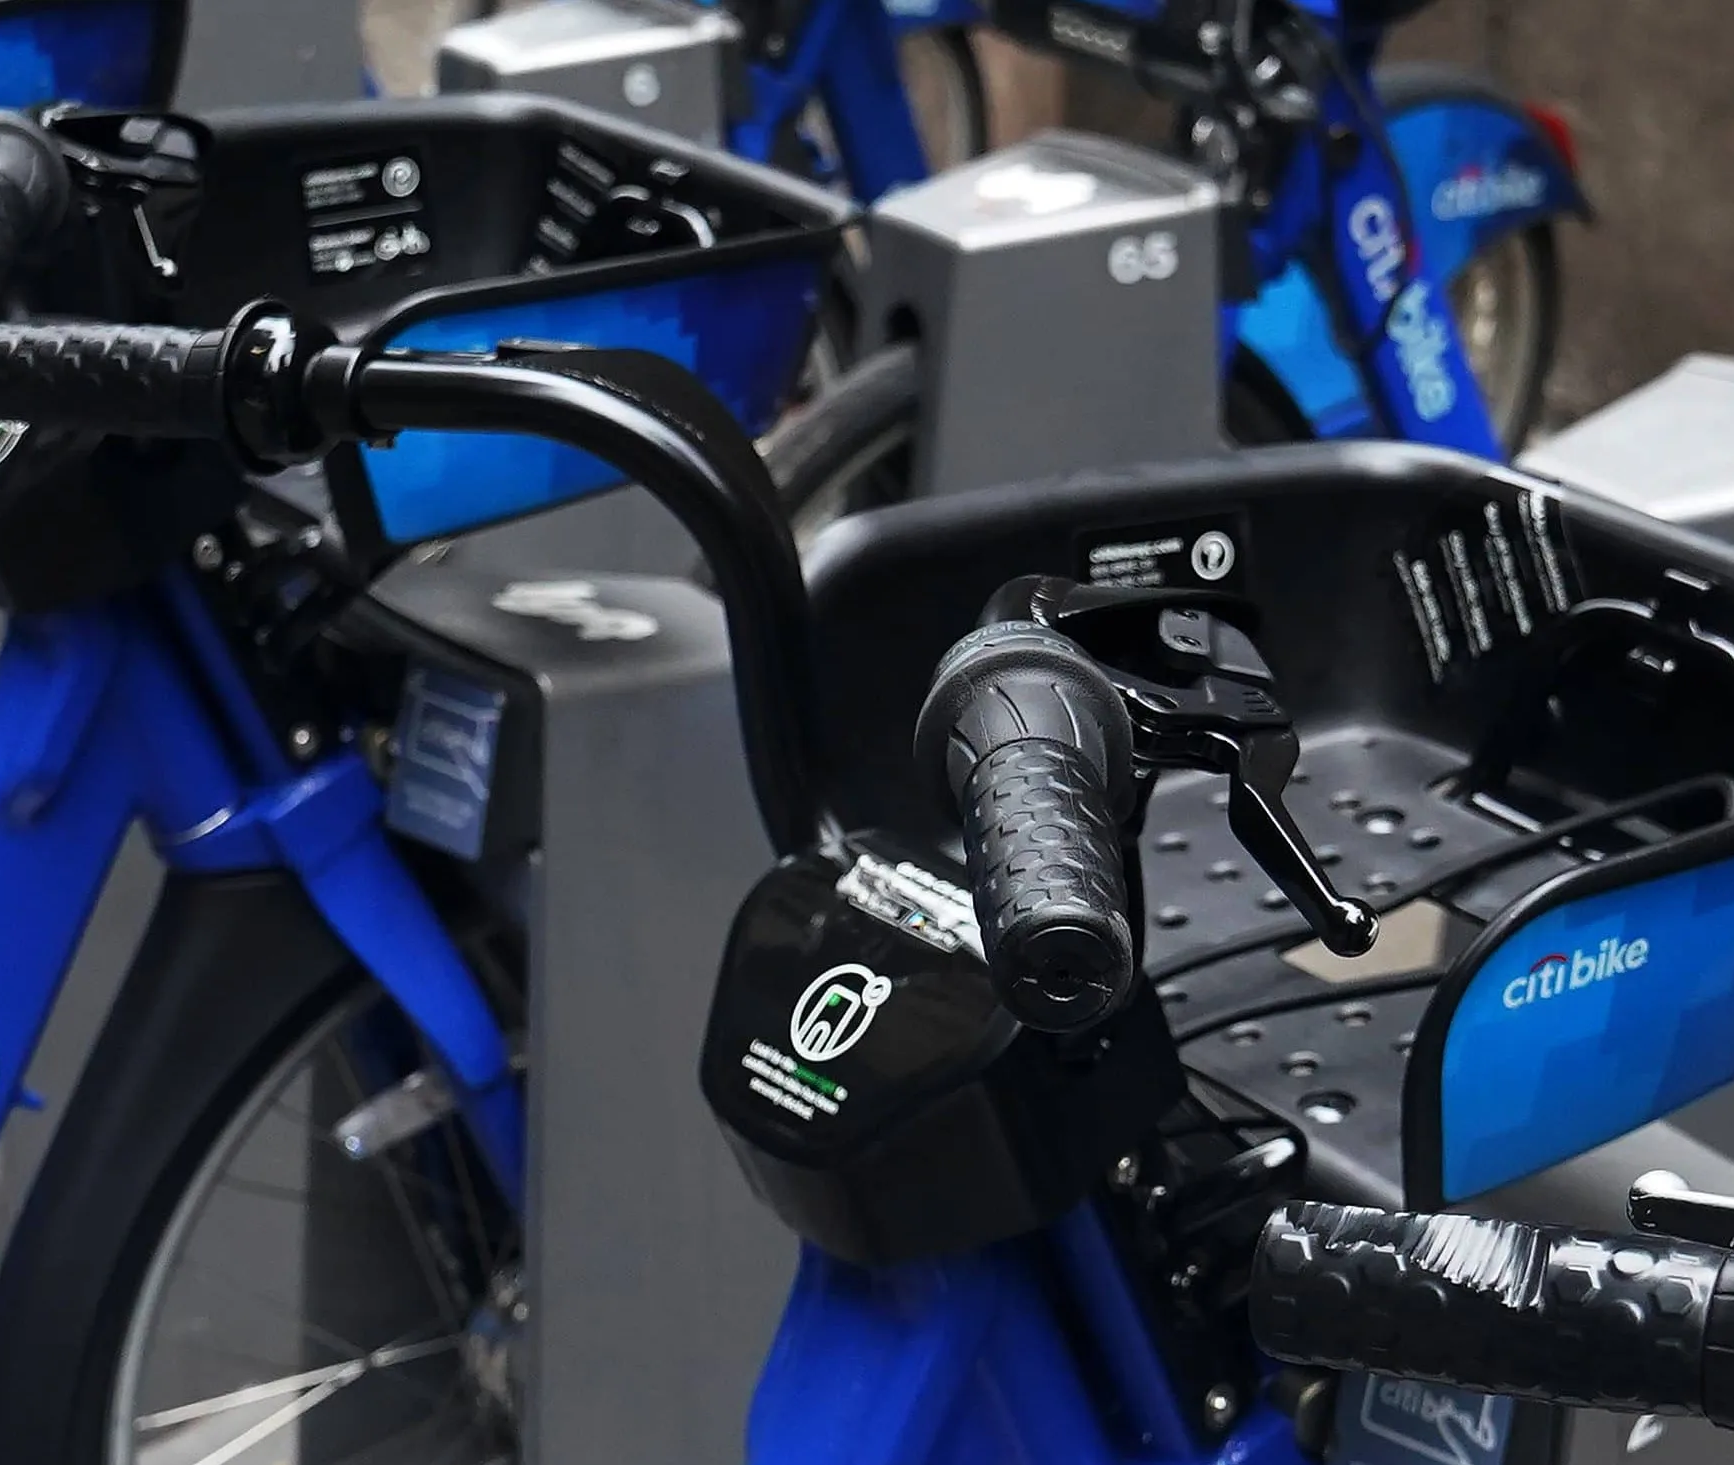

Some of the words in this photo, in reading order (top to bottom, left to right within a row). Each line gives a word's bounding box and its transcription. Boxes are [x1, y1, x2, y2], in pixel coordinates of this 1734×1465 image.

[1107, 231, 1179, 285] 65
[1503, 953, 1569, 1009] citi
[1569, 938, 1650, 990] bike
